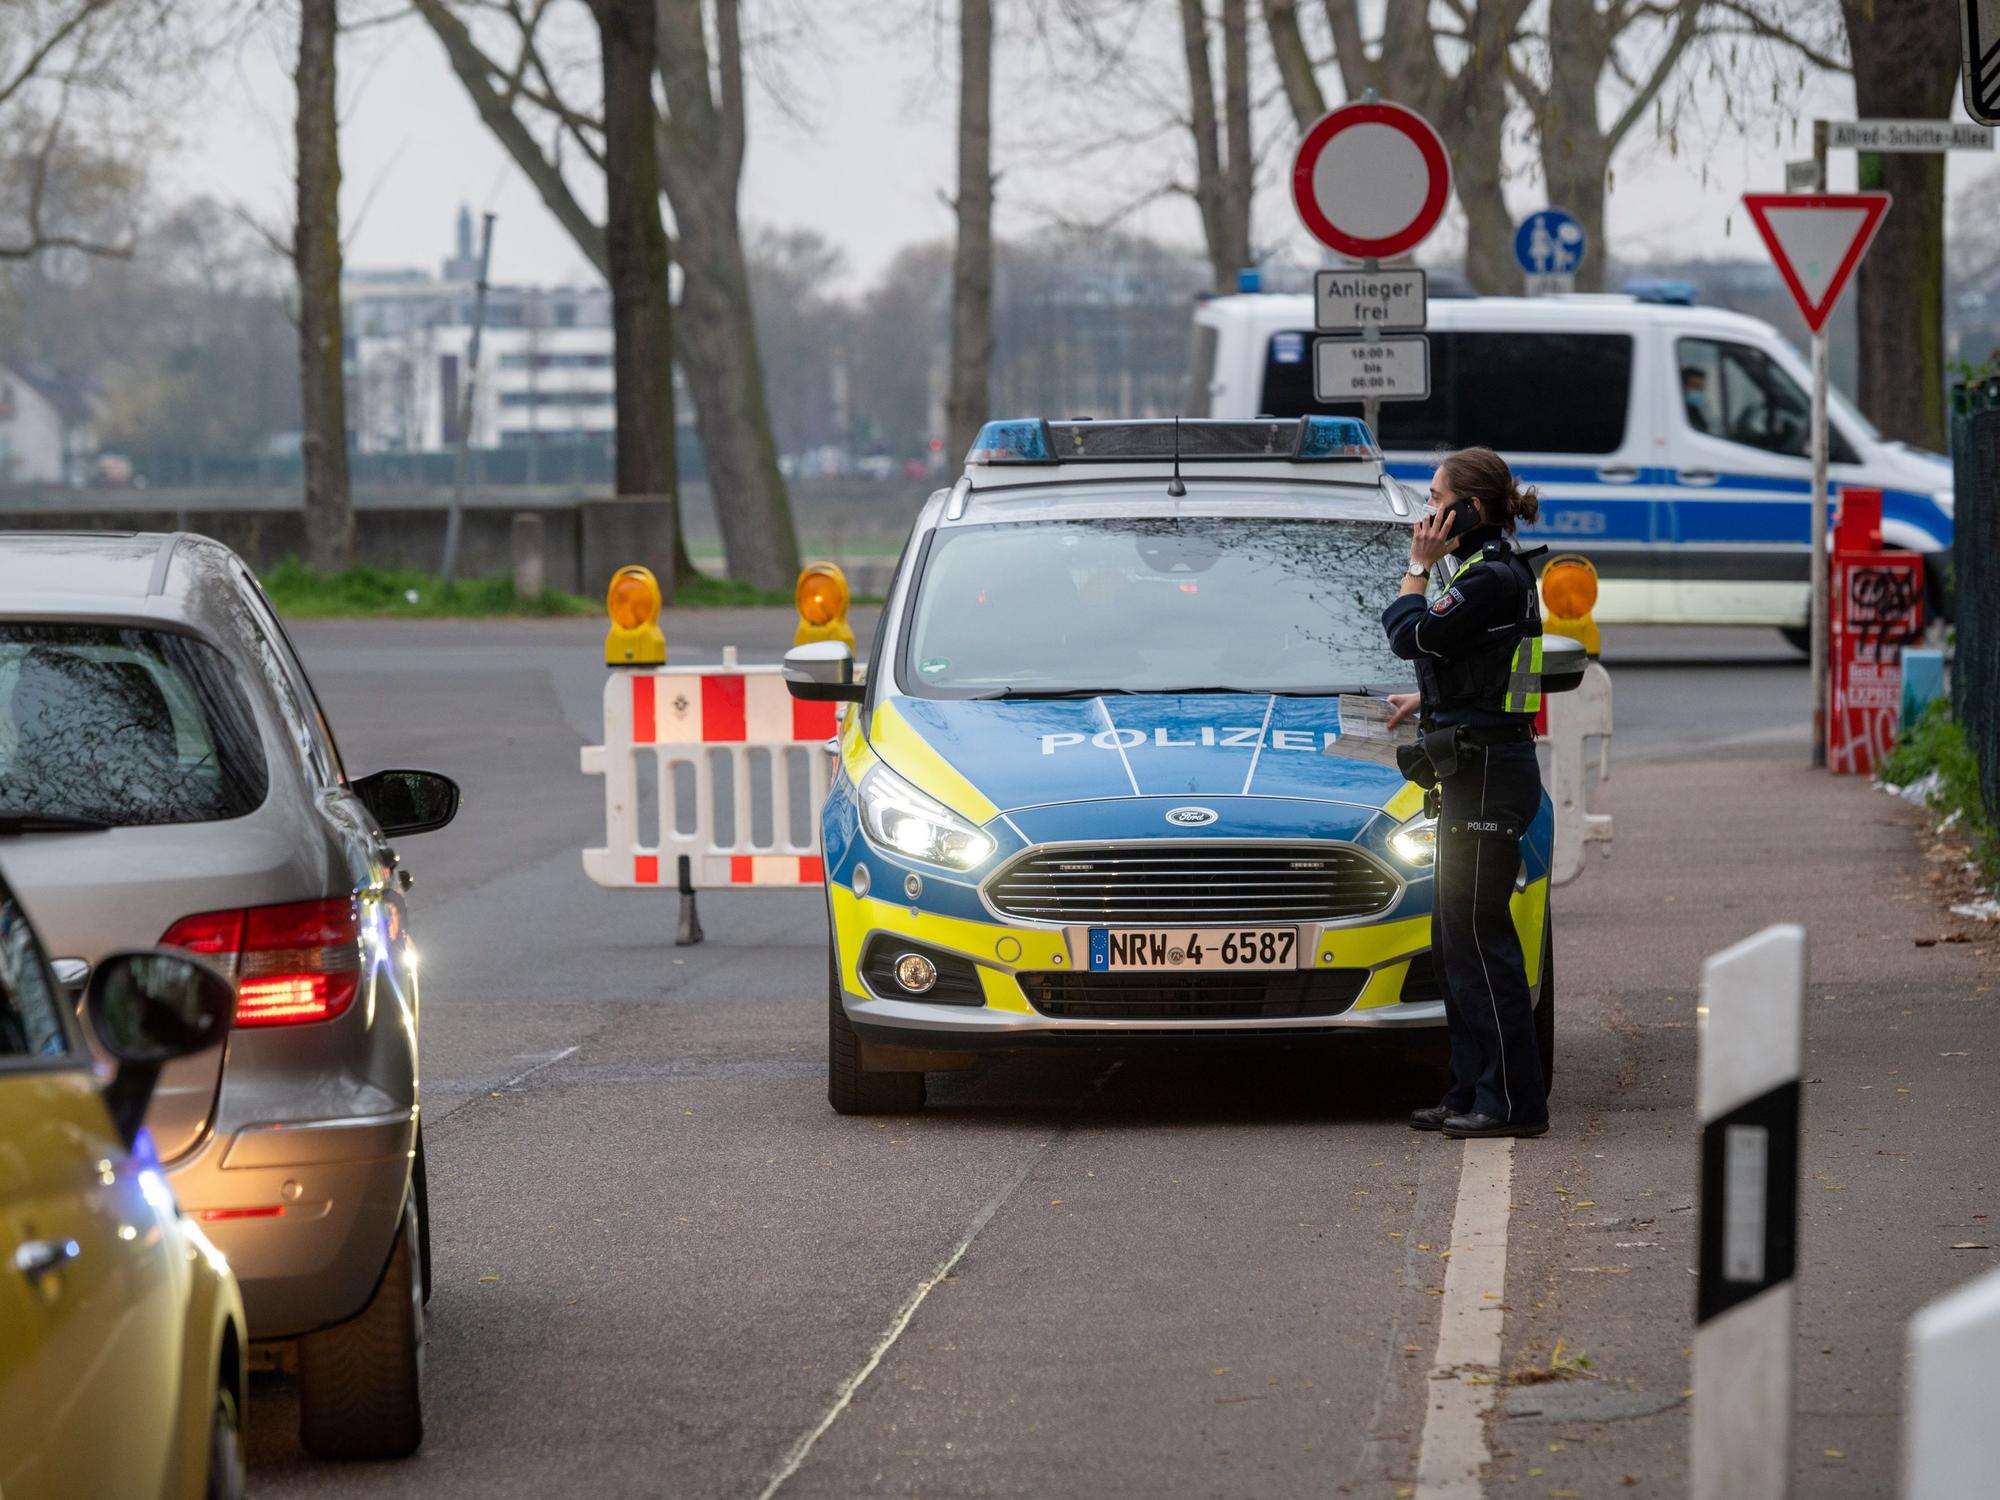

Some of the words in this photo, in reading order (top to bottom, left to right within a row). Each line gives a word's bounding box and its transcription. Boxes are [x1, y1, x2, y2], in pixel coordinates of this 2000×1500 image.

[1328, 280, 1413, 301] Anlieger
[1354, 302, 1389, 320] frei
[1042, 726, 1337, 755] POLIZEI
[1179, 811, 1205, 821] Ford
[1467, 821, 1498, 832] POLIZEI
[1109, 932, 1167, 966] NRW
[1186, 931, 1295, 965] 4-6587
[1095, 953, 1104, 964] D
